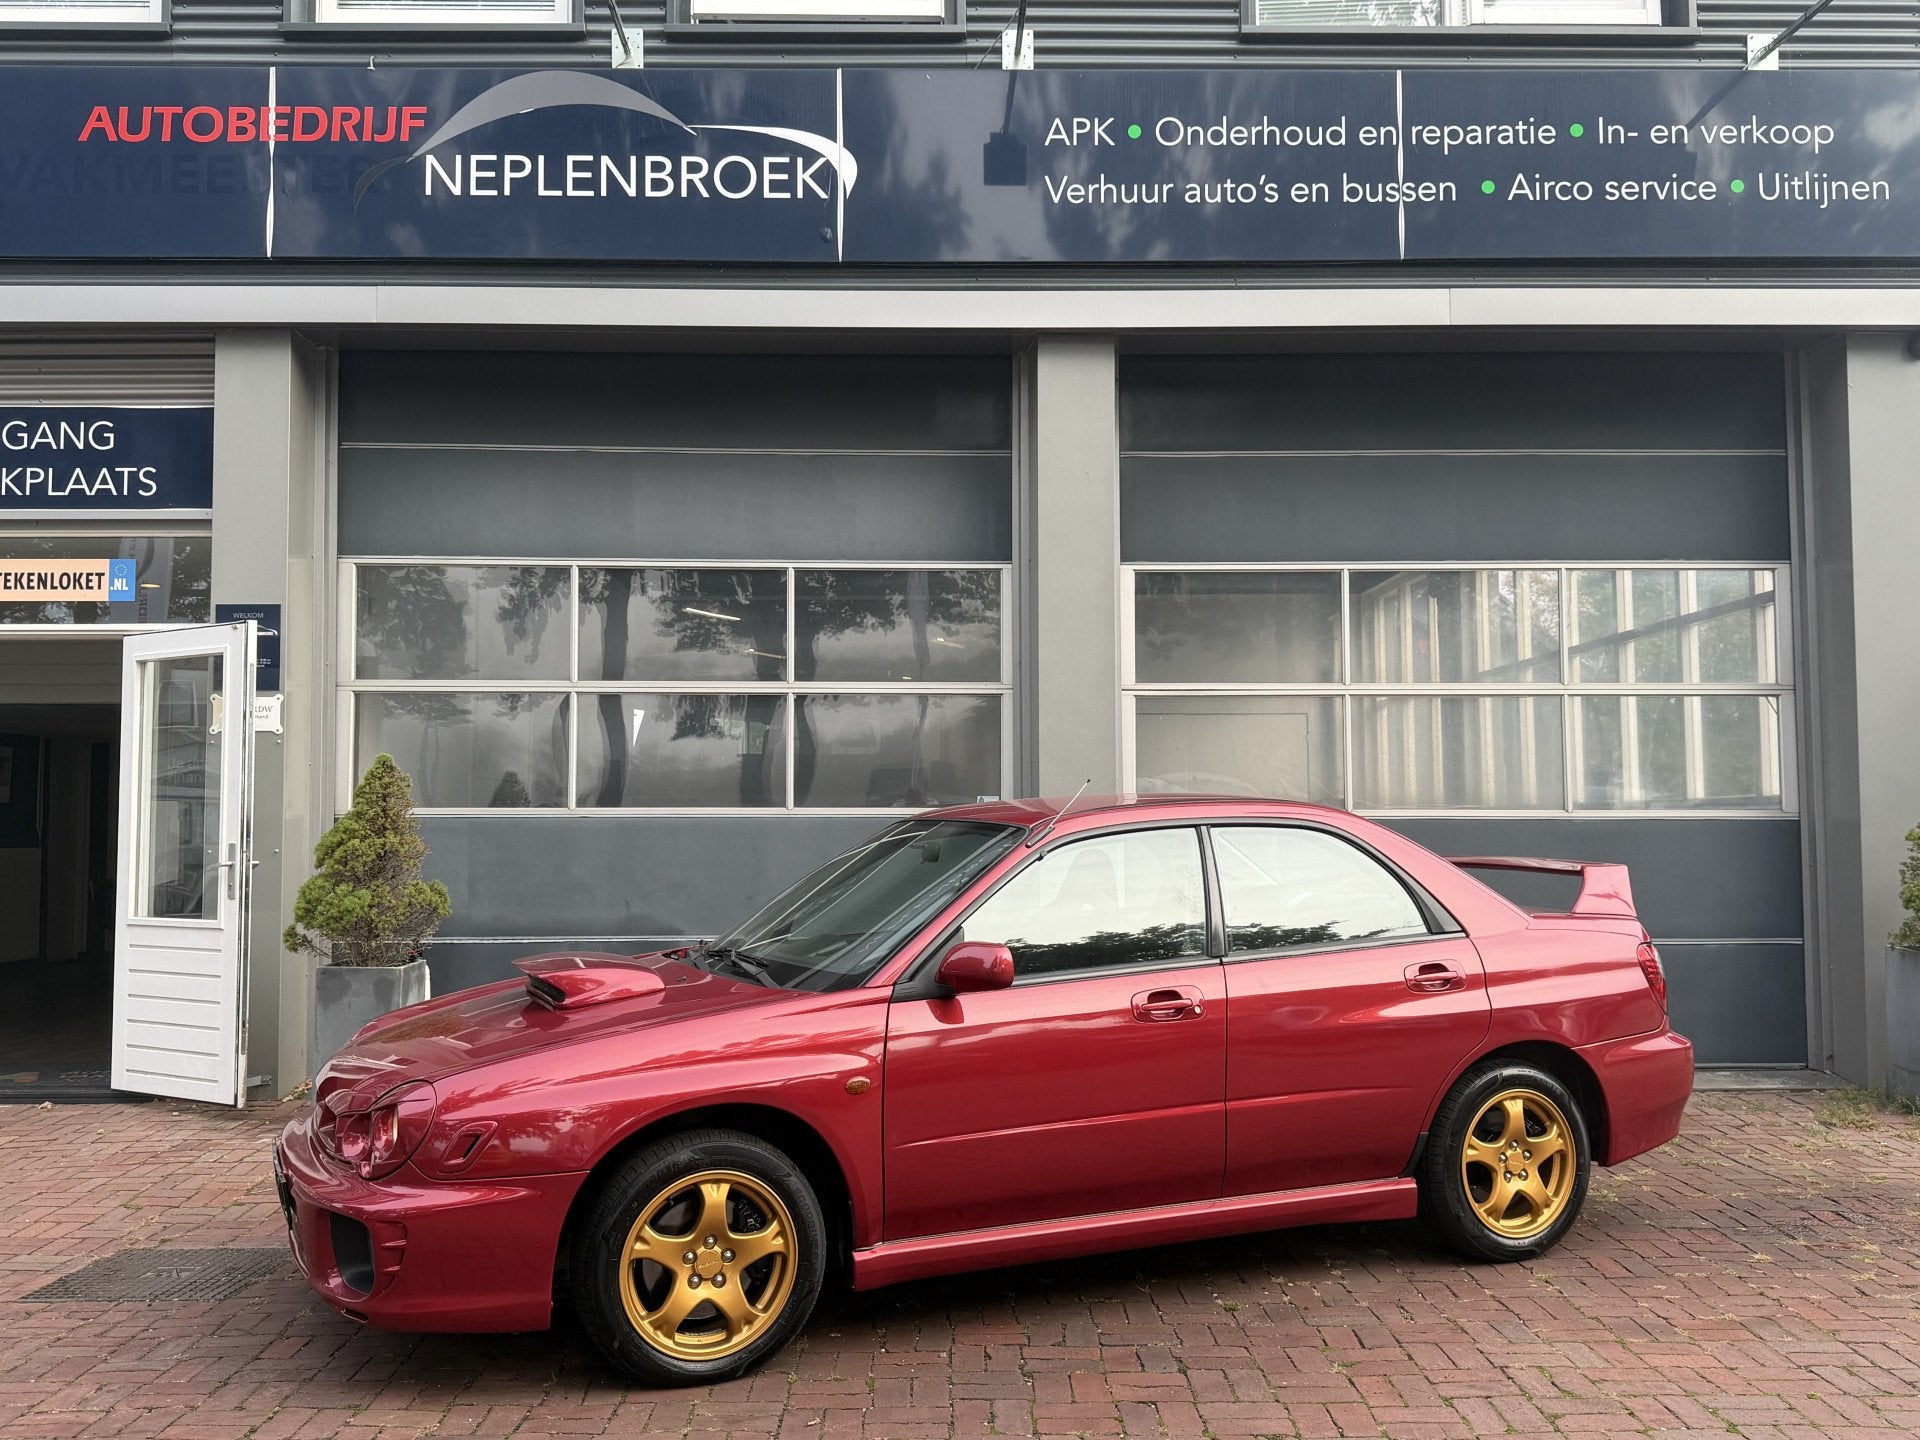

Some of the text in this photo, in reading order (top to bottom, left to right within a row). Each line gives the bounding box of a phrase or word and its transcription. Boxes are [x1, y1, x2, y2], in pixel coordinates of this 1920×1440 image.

[78, 106, 428, 143] AUTOBEDRIJF
[1044, 114, 1835, 155] APK Onderhoud en reparatie In- en verkoop
[424, 153, 830, 199] NEPLENBROEK
[1044, 170, 1890, 209] Verhuur auto's en bussen Airco service Uitlijnen
[2, 420, 115, 451] GANG
[1, 466, 157, 497] KPLAATS
